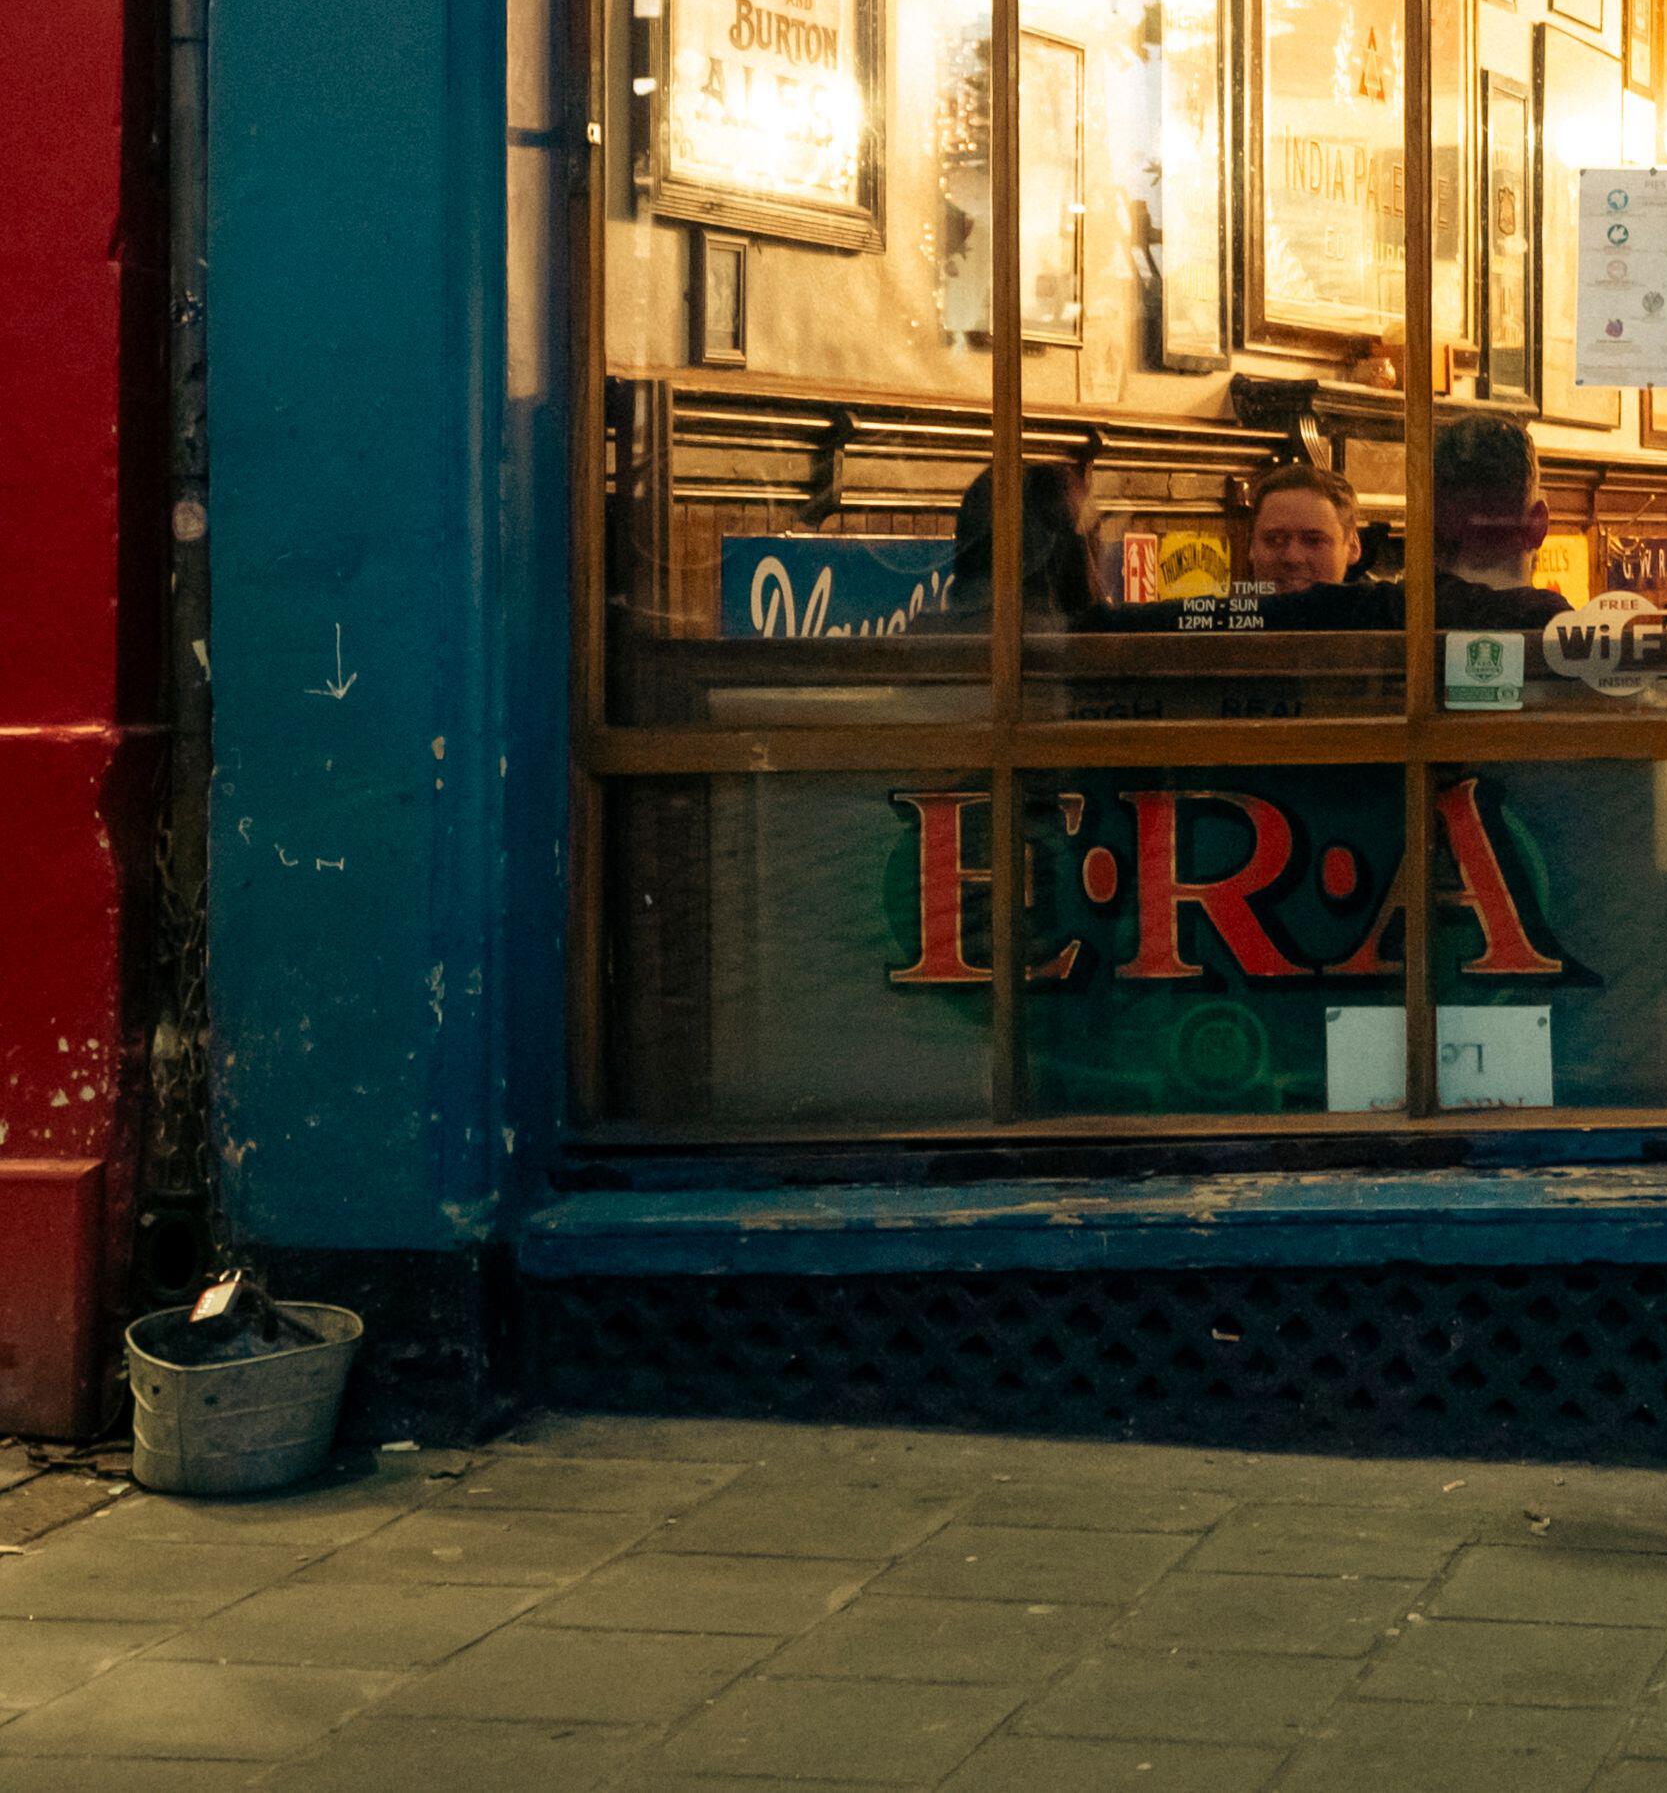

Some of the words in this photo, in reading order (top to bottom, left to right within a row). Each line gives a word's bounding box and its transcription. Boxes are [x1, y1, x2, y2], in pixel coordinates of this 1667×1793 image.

[1233, 581, 1276, 595] TIMES
[1183, 599, 1215, 612] MON
[1229, 598, 1258, 612] SUN
[1599, 599, 1639, 611] FREE
[1177, 616, 1213, 630] 12PM
[1228, 616, 1264, 629] 12AM
[1598, 677, 1641, 688] INSIDE
